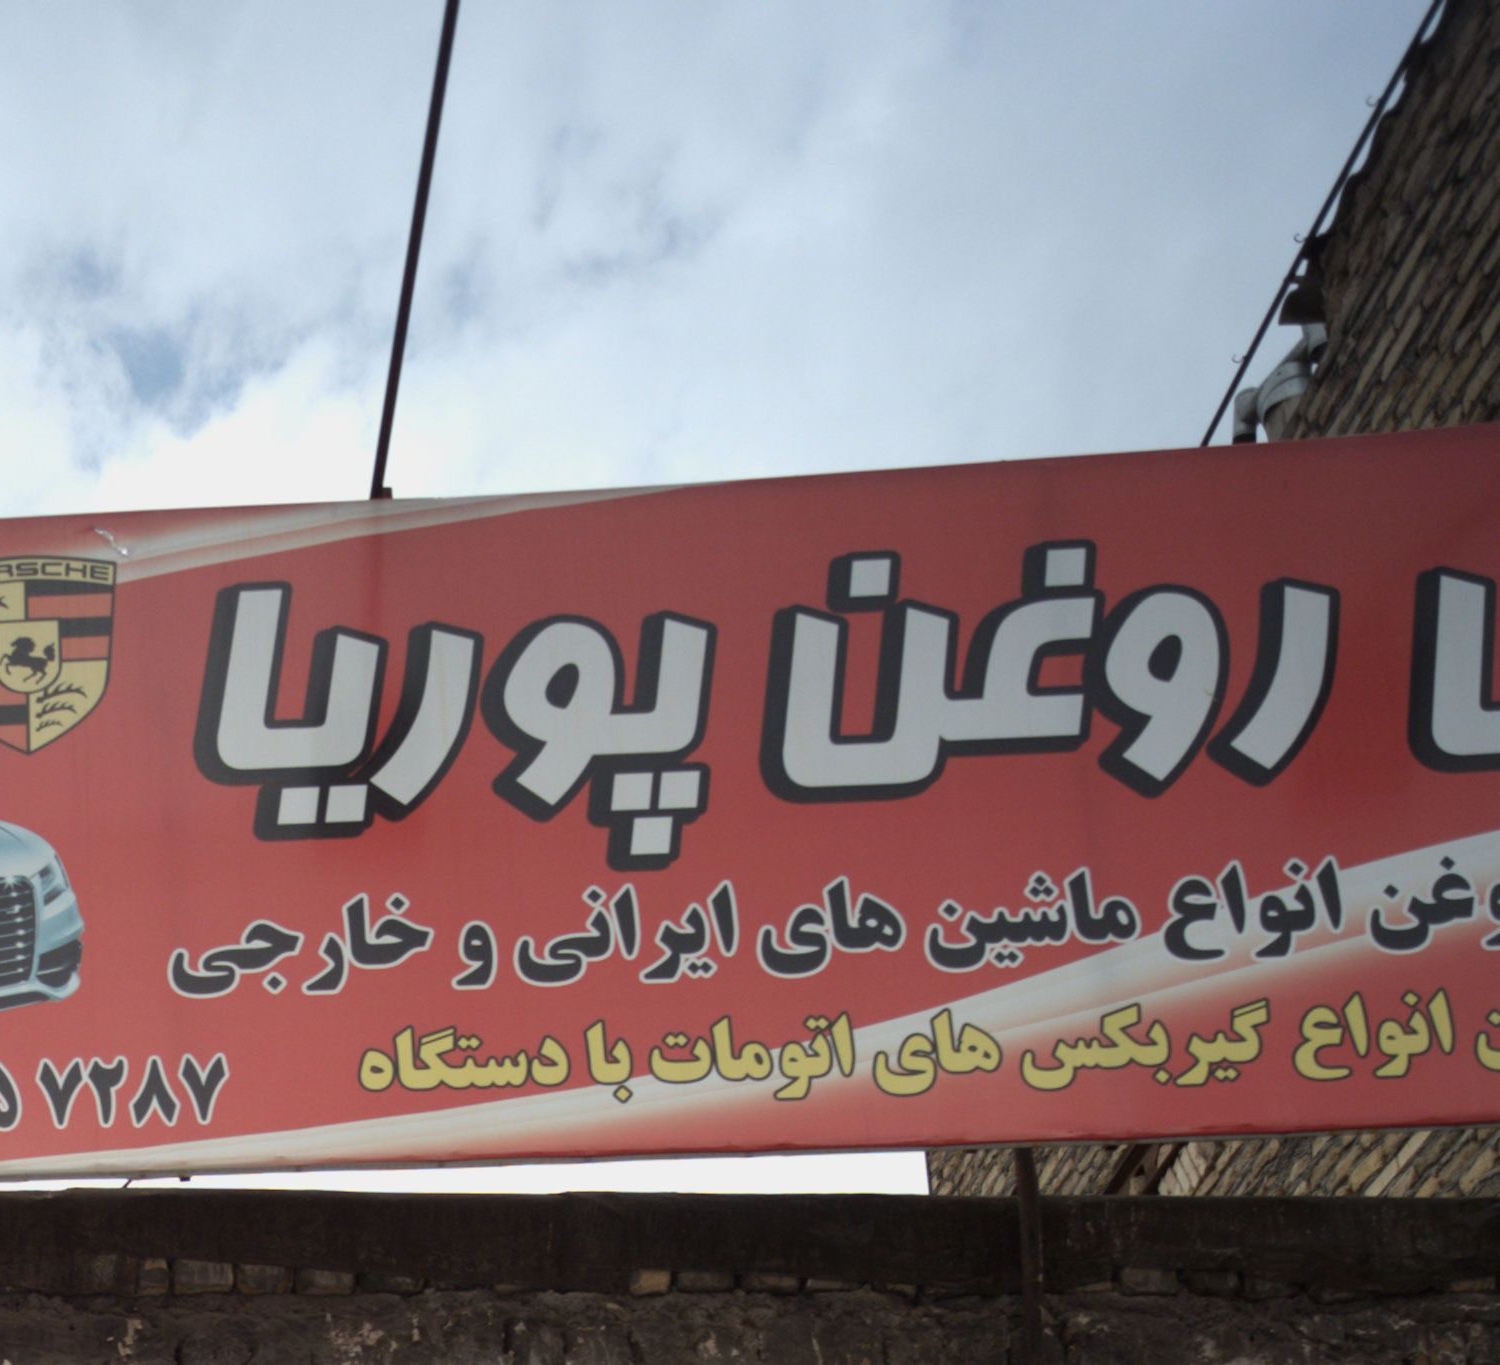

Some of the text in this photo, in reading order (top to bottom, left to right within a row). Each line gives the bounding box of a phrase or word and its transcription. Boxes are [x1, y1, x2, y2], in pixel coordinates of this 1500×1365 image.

[762, 541, 1338, 801] روغن
[199, 582, 714, 868] پوریا
[168, 891, 434, 999] خارجی
[453, 919, 498, 989] و
[515, 879, 740, 987] ایرانی
[758, 876, 905, 978] های
[925, 866, 1140, 970] ماشین
[1164, 856, 1344, 961] انواع
[358, 1026, 570, 1093] دستگاه
[584, 1019, 632, 1103] با
[649, 1011, 855, 1101] اتومات
[873, 1009, 1002, 1097] های
[1020, 998, 1269, 1091] گیربکس
[1293, 988, 1454, 1080] انواع
